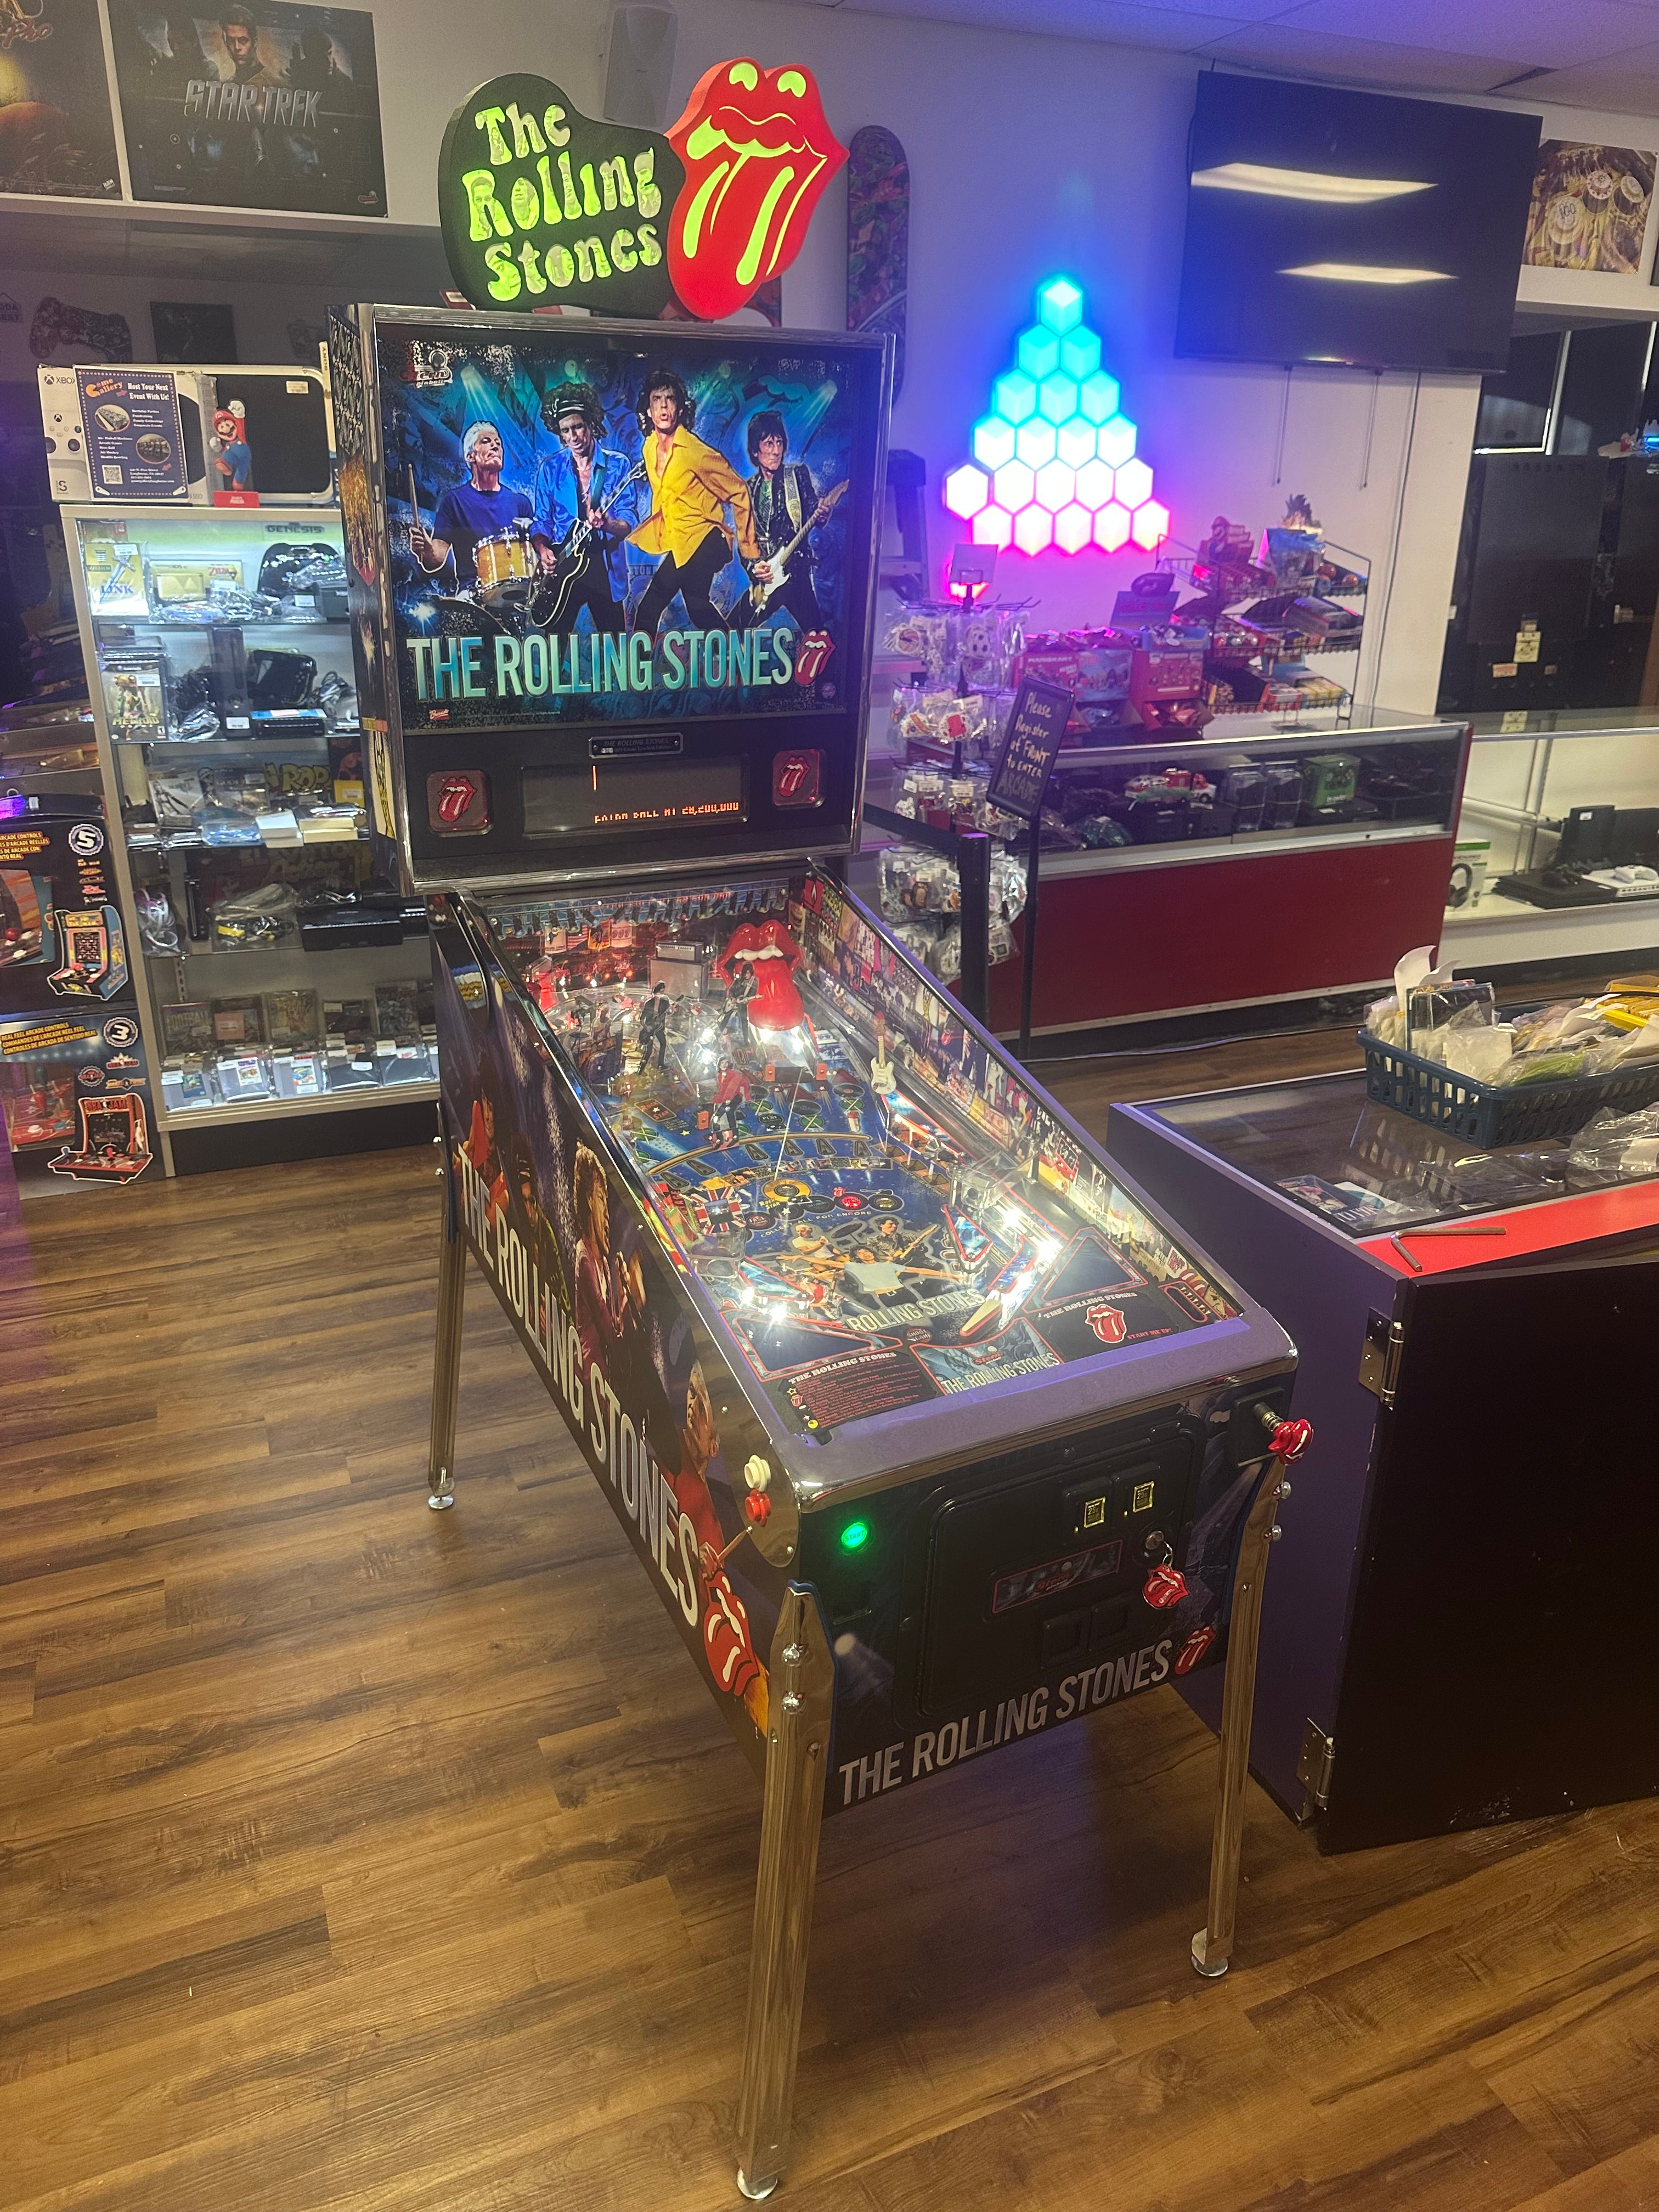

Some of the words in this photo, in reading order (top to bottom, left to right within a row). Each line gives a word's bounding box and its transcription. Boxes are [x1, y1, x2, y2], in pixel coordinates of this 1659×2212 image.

[184, 80, 258, 122] STAR
[263, 86, 323, 128] TREK
[475, 102, 571, 166] The
[461, 146, 663, 241] Rolling
[485, 223, 663, 302] Stones
[59, 481, 67, 492] S
[267, 525, 324, 534] GENESIS
[406, 635, 486, 702] THE
[496, 631, 653, 697] ROLLING
[663, 627, 793, 690] STONES
[1025, 691, 1052, 719] Please
[1015, 714, 1049, 740] Register
[1010, 736, 1021, 753] at
[1007, 753, 1015, 769] to
[1017, 761, 1042, 778] ENTER
[44, 1022, 69, 1031] CONTROLS
[87, 1101, 102, 1111] NBA
[108, 1098, 127, 1110] JAM
[640, 1101, 658, 1111] ROCK
[653, 1110, 670, 1120] STAR
[759, 1197, 776, 1207] ROCK
[766, 1201, 781, 1210] STAR
[847, 1302, 923, 1332] ROLLING
[917, 1288, 986, 1316] STONES
[1043, 1308, 1064, 1319] THE
[1064, 1296, 1104, 1312] ROLLING
[1104, 1292, 1138, 1301] STONES
[1127, 1331, 1149, 1340] START
[788, 1372, 811, 1384] THE
[811, 1358, 858, 1376] ROLLING
[857, 1352, 897, 1363] STONES
[940, 1377, 970, 1395] THE
[964, 1363, 1018, 1389] ROLLING
[1014, 1352, 1061, 1375] STONES
[456, 1144, 495, 1269] THE
[494, 1202, 585, 1431] ROLLING
[589, 1361, 699, 1628] STONES
[844, 1530, 866, 1542] START
[839, 1741, 905, 1806] THE
[912, 1686, 1049, 1778] ROLLING
[1055, 1639, 1172, 1719] STONES
